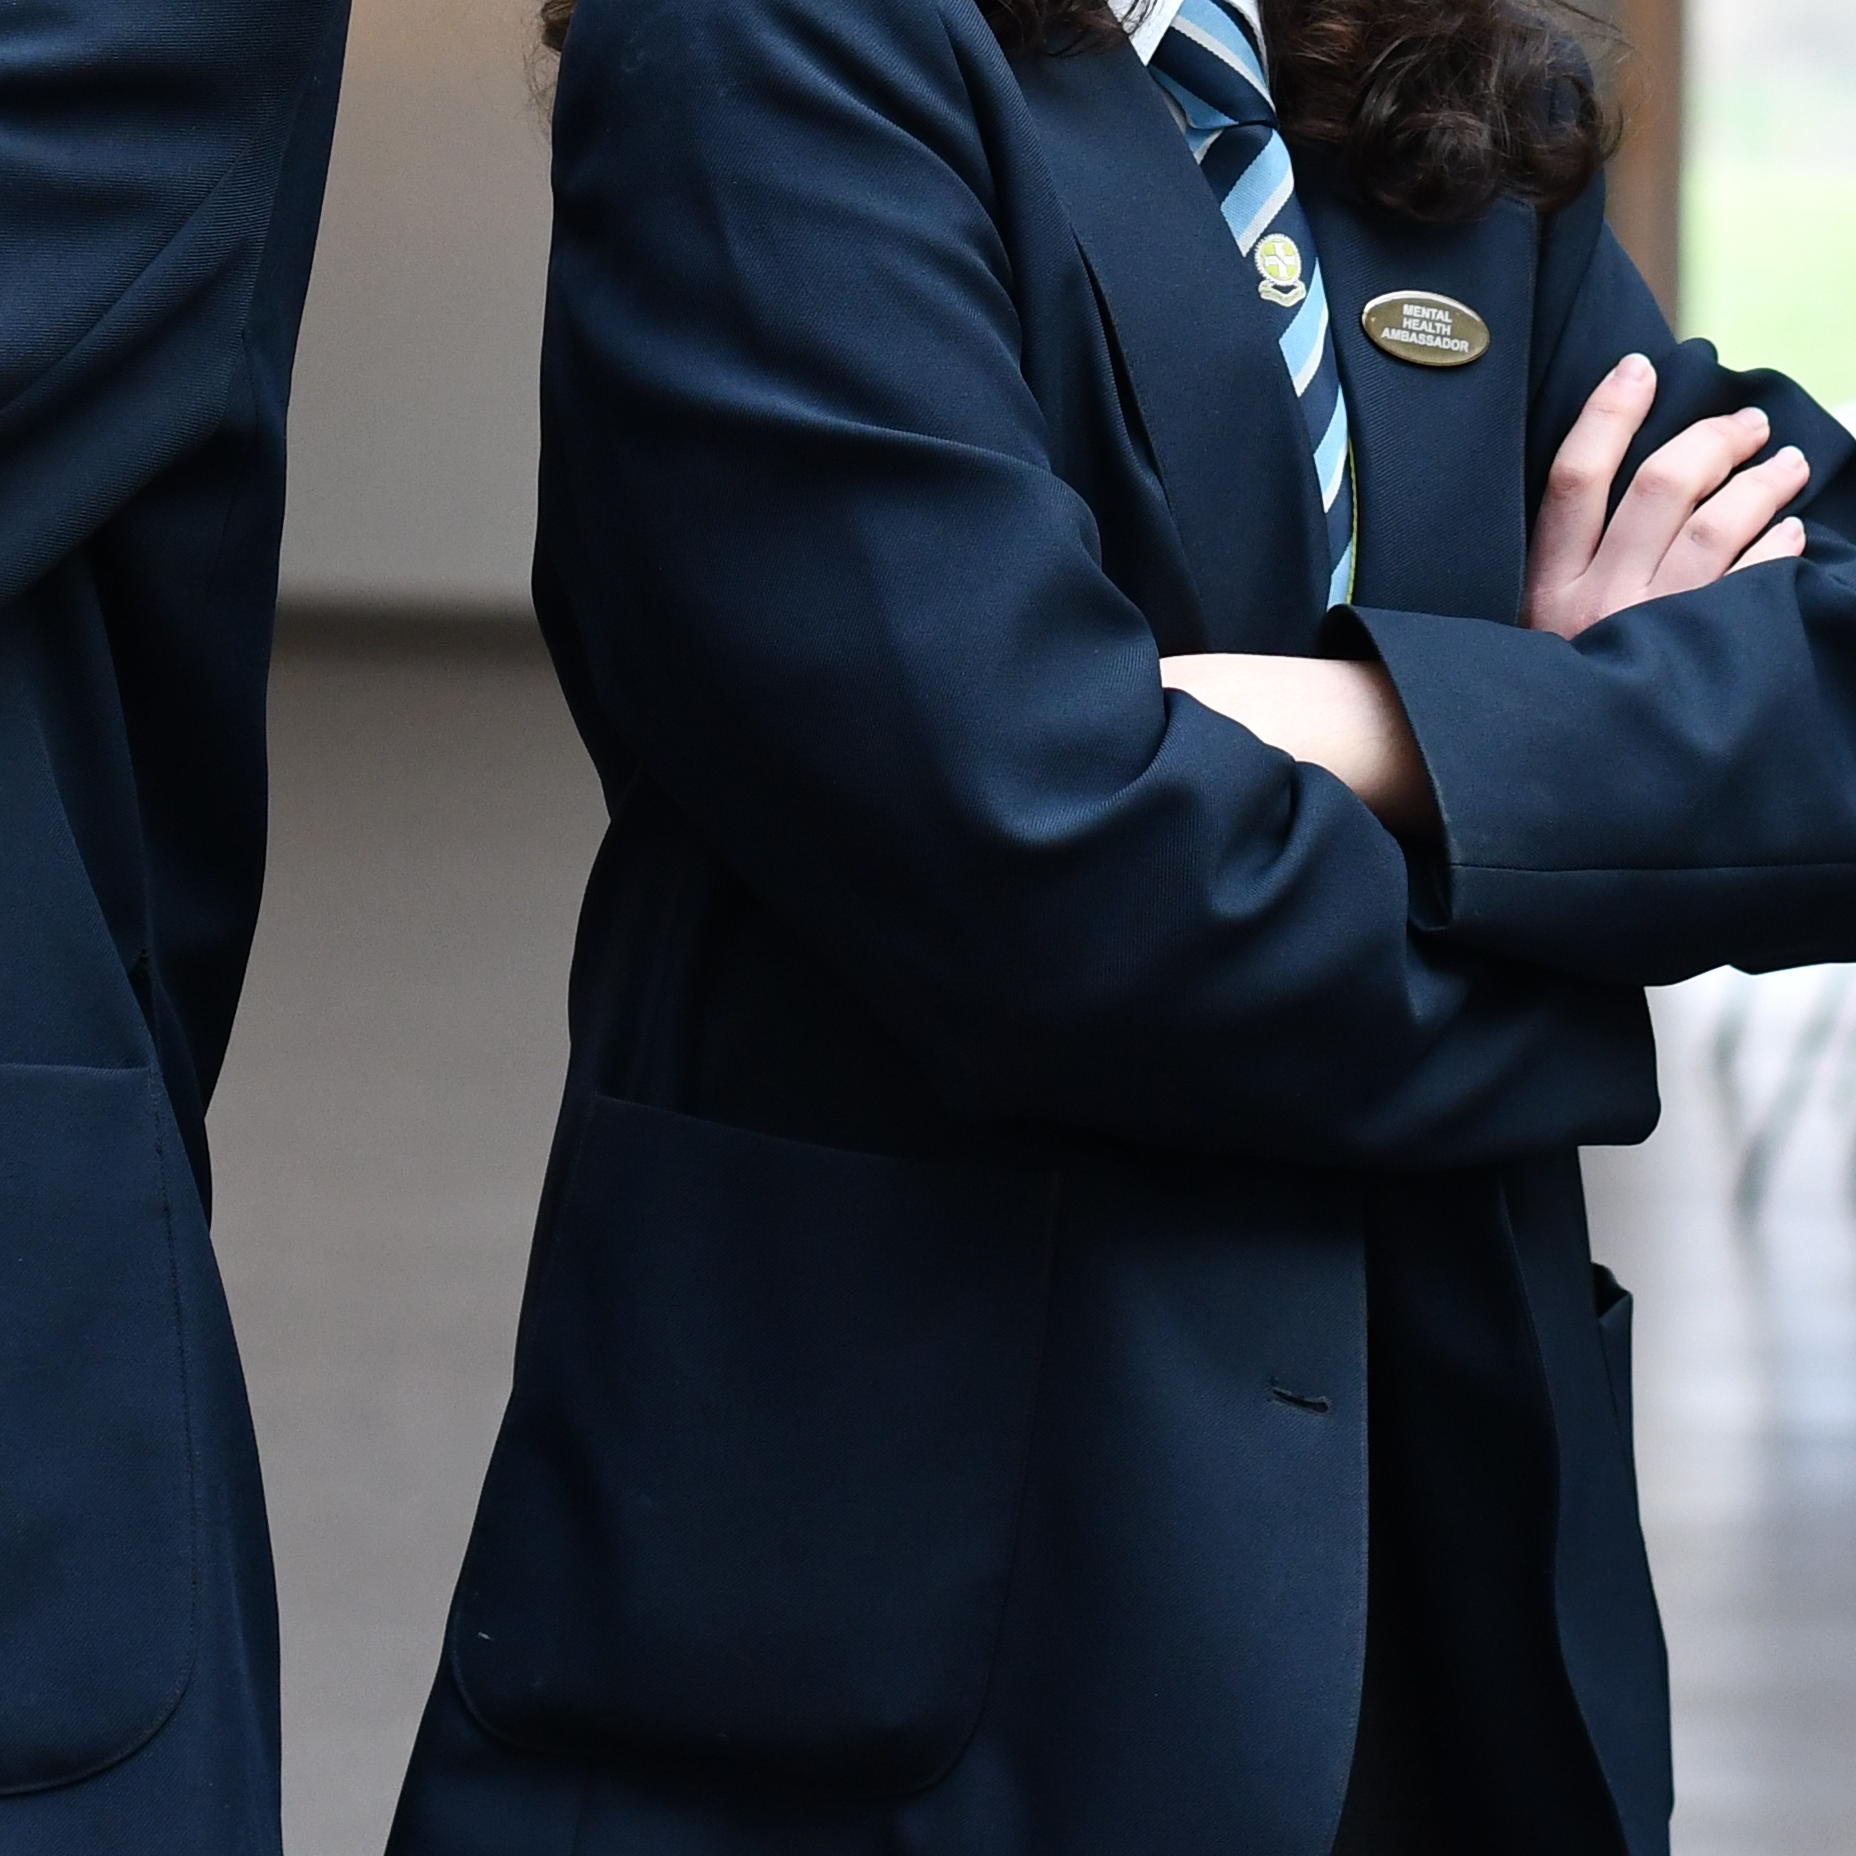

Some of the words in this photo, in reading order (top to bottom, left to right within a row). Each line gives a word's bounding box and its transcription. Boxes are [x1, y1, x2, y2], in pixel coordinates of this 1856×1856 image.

[1402, 303, 1454, 323] MENTAL
[1402, 318, 1452, 337] HEALTH
[1380, 327, 1471, 354] AMBASSADOR
